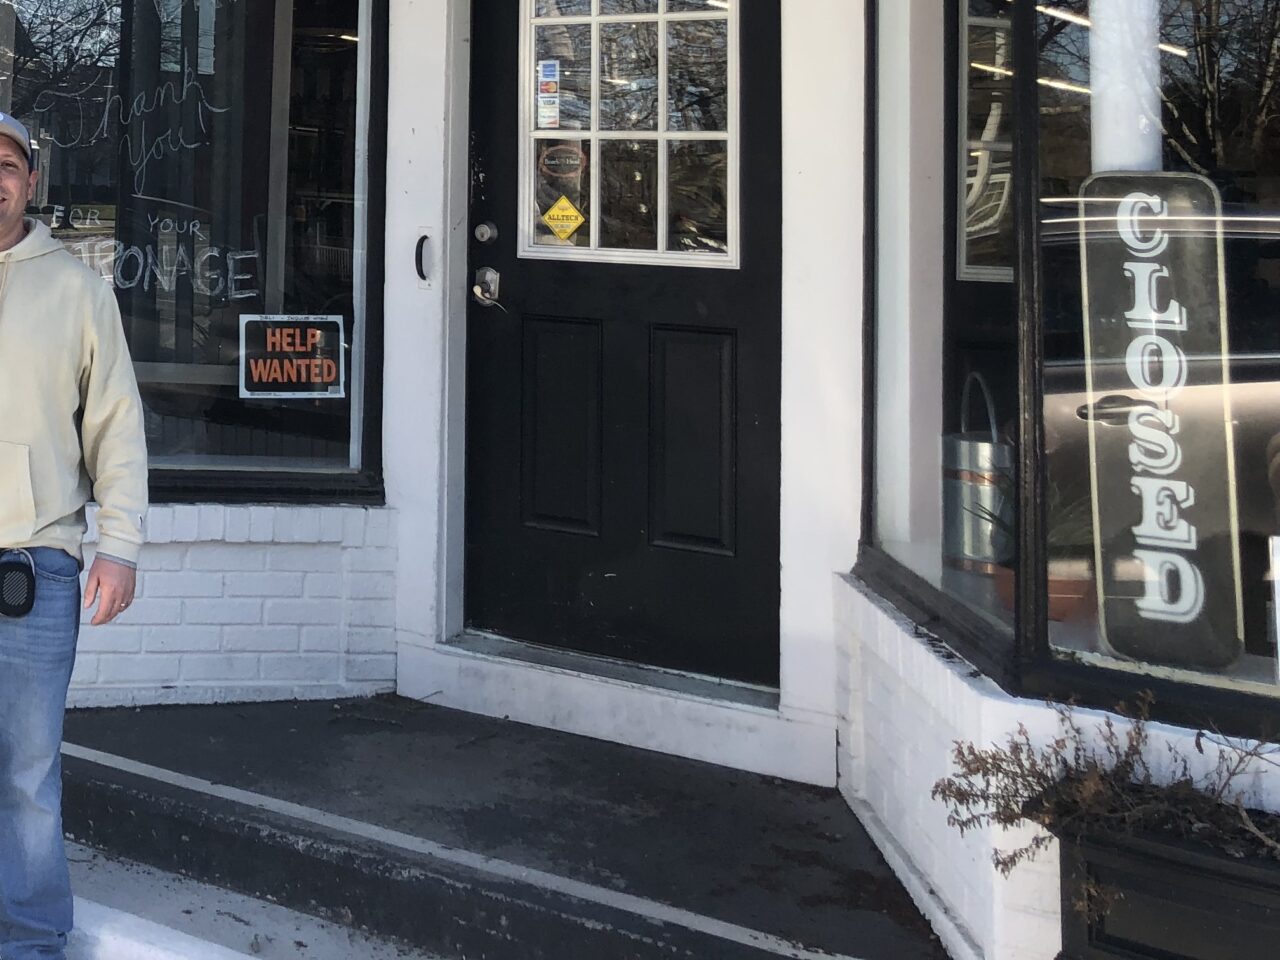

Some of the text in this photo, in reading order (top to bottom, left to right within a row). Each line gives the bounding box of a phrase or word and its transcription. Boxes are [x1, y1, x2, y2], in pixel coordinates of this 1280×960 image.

[52, 204, 208, 241] FOR YOUR
[265, 327, 320, 353] HELP
[248, 358, 338, 383] WANTED
[1116, 191, 1206, 624] CLOSED
